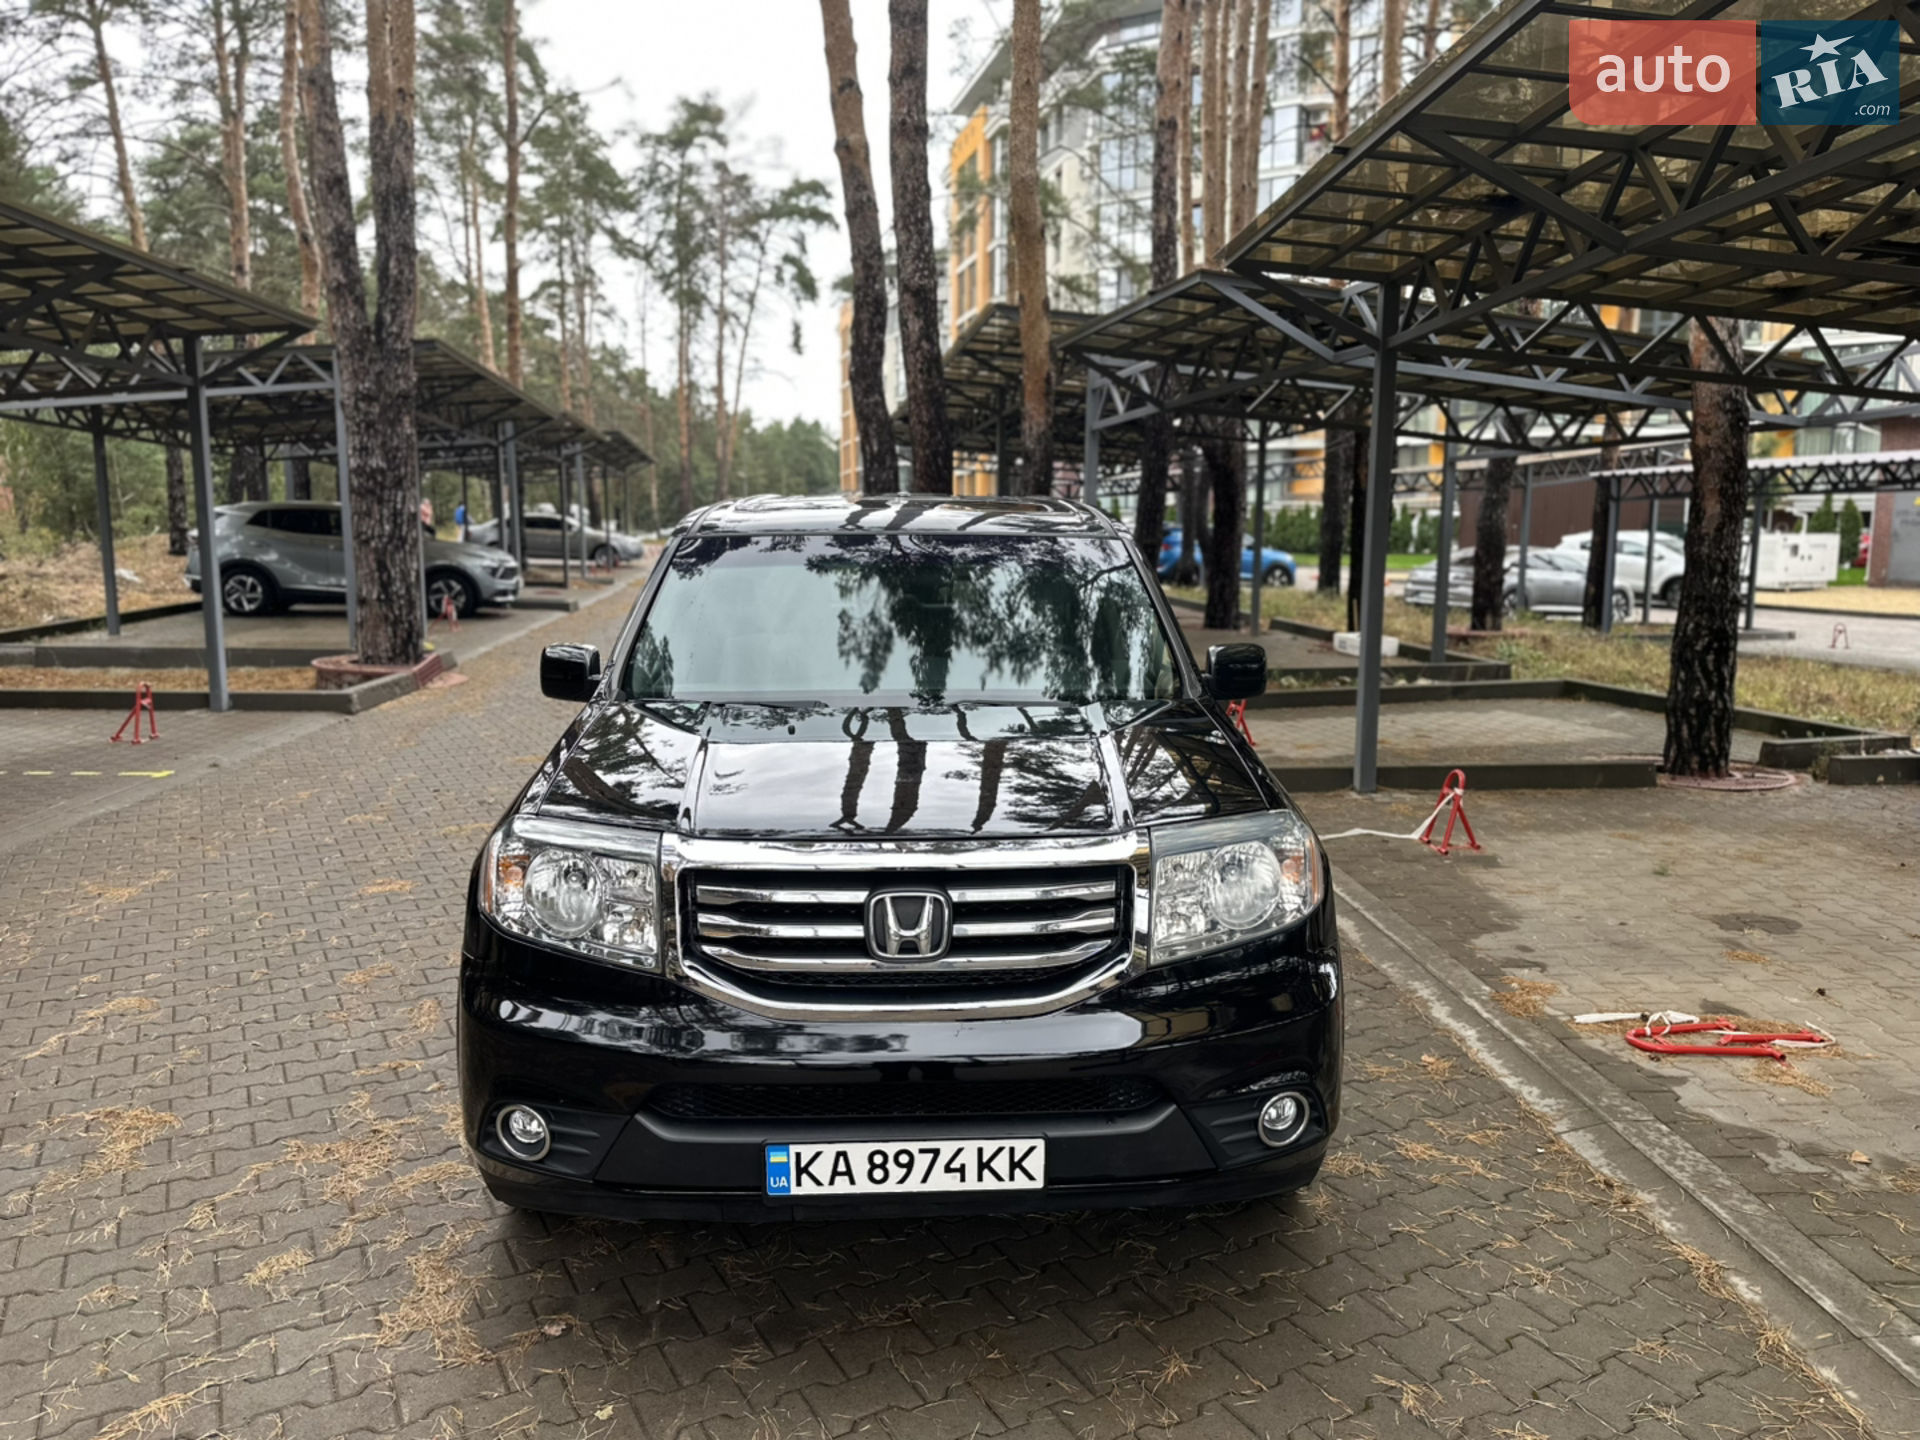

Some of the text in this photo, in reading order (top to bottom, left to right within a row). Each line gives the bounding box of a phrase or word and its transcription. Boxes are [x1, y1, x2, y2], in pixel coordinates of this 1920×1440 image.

[794, 1145, 1038, 1187] KA 8974 KK
[769, 1176, 789, 1188] UA
